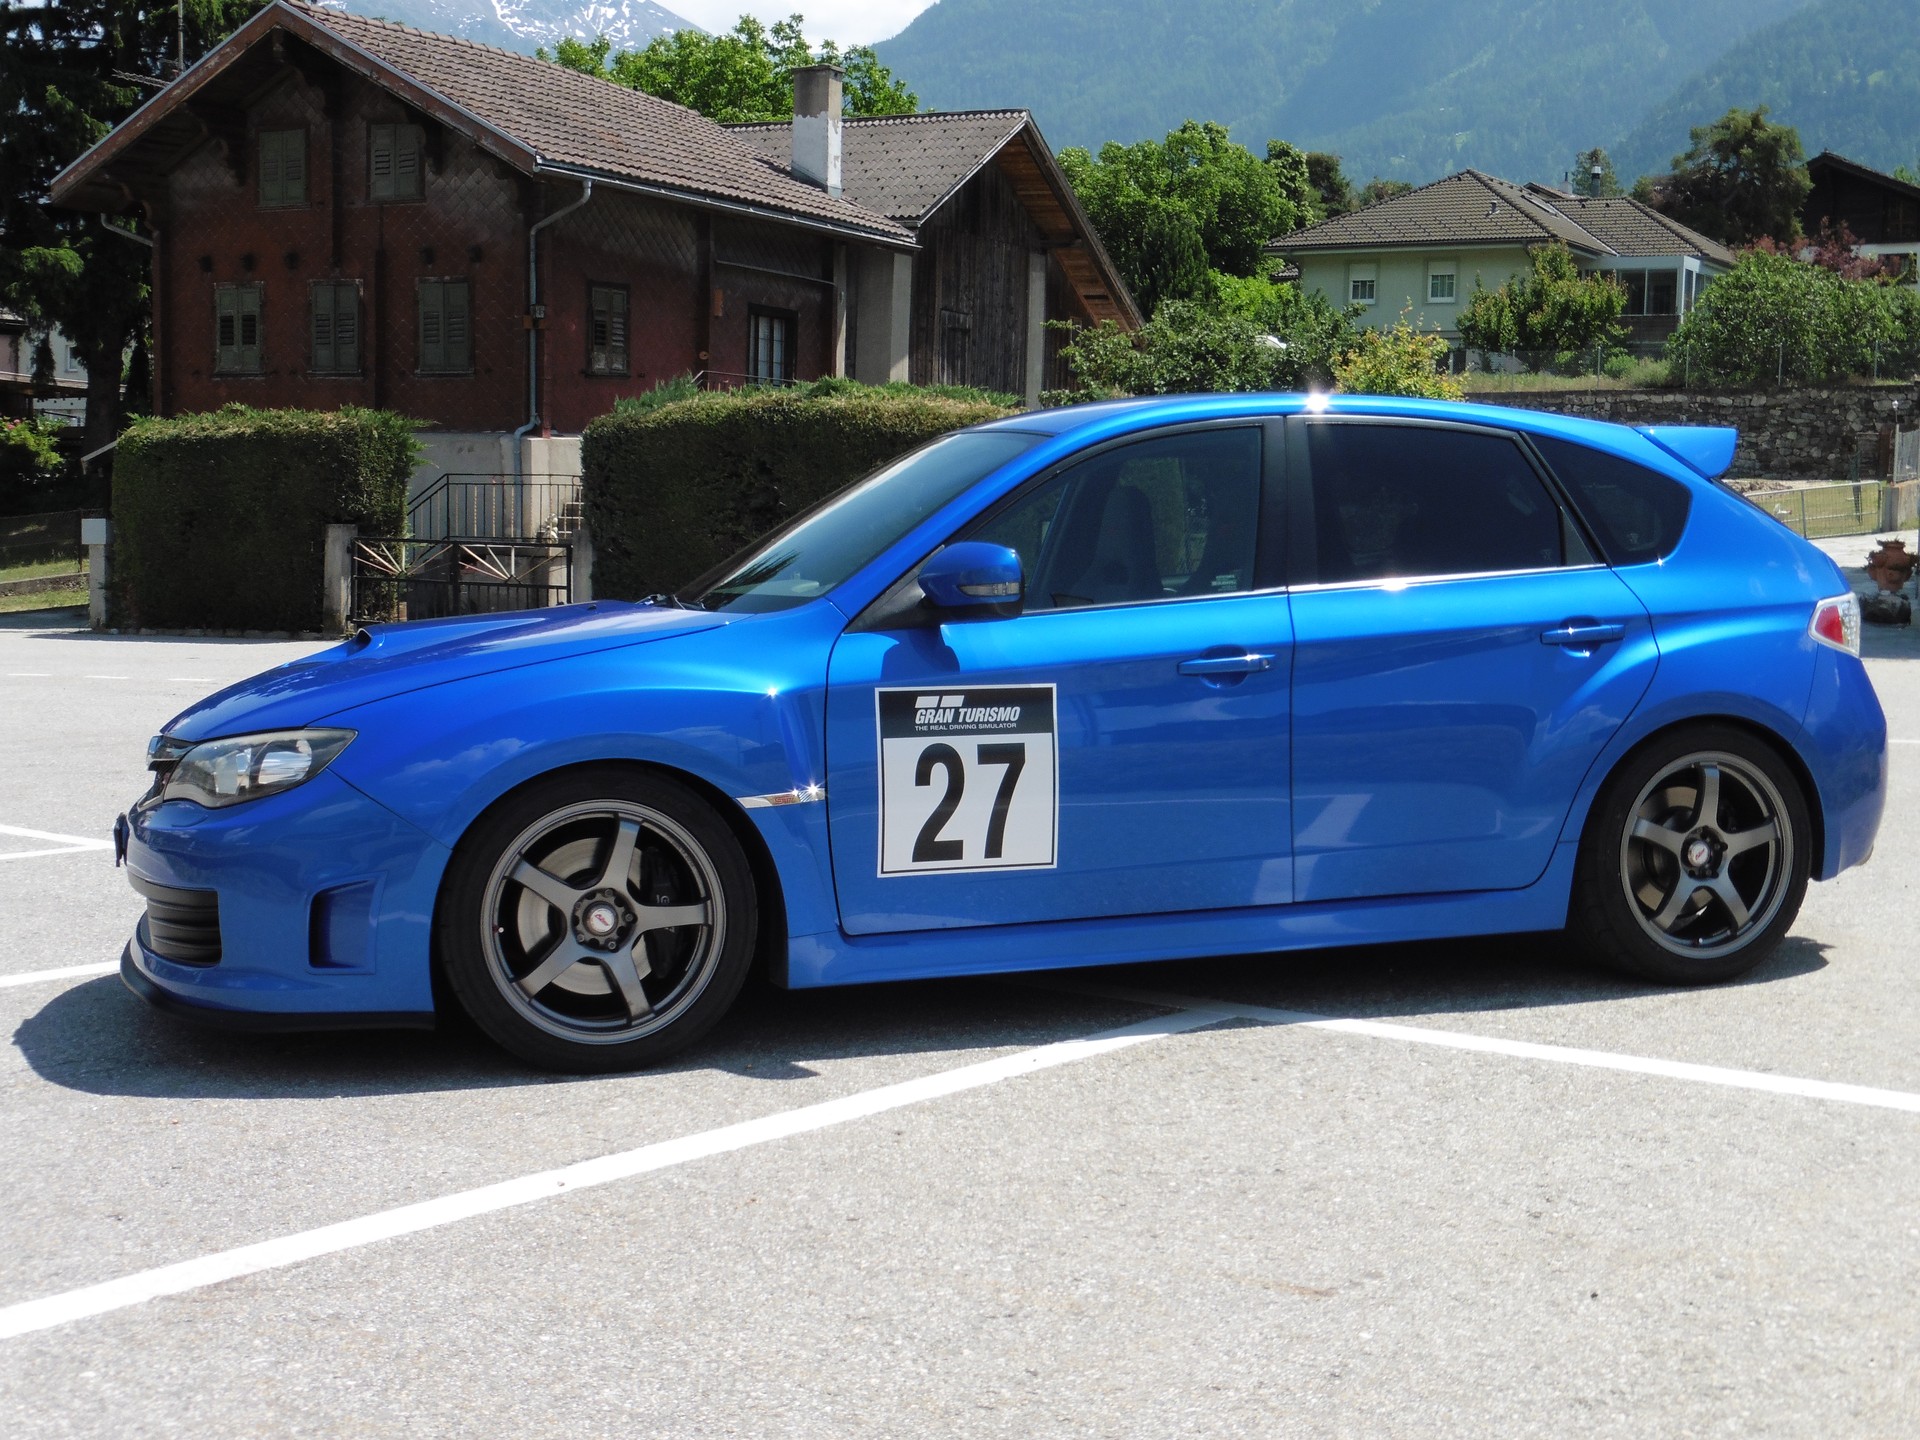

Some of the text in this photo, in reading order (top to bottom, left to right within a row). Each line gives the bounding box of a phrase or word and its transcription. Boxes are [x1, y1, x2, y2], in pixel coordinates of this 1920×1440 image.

[915, 706, 1021, 724] GRAN TURISMO
[978, 722, 1017, 730] SIMULATOR
[912, 742, 1026, 862] 27
